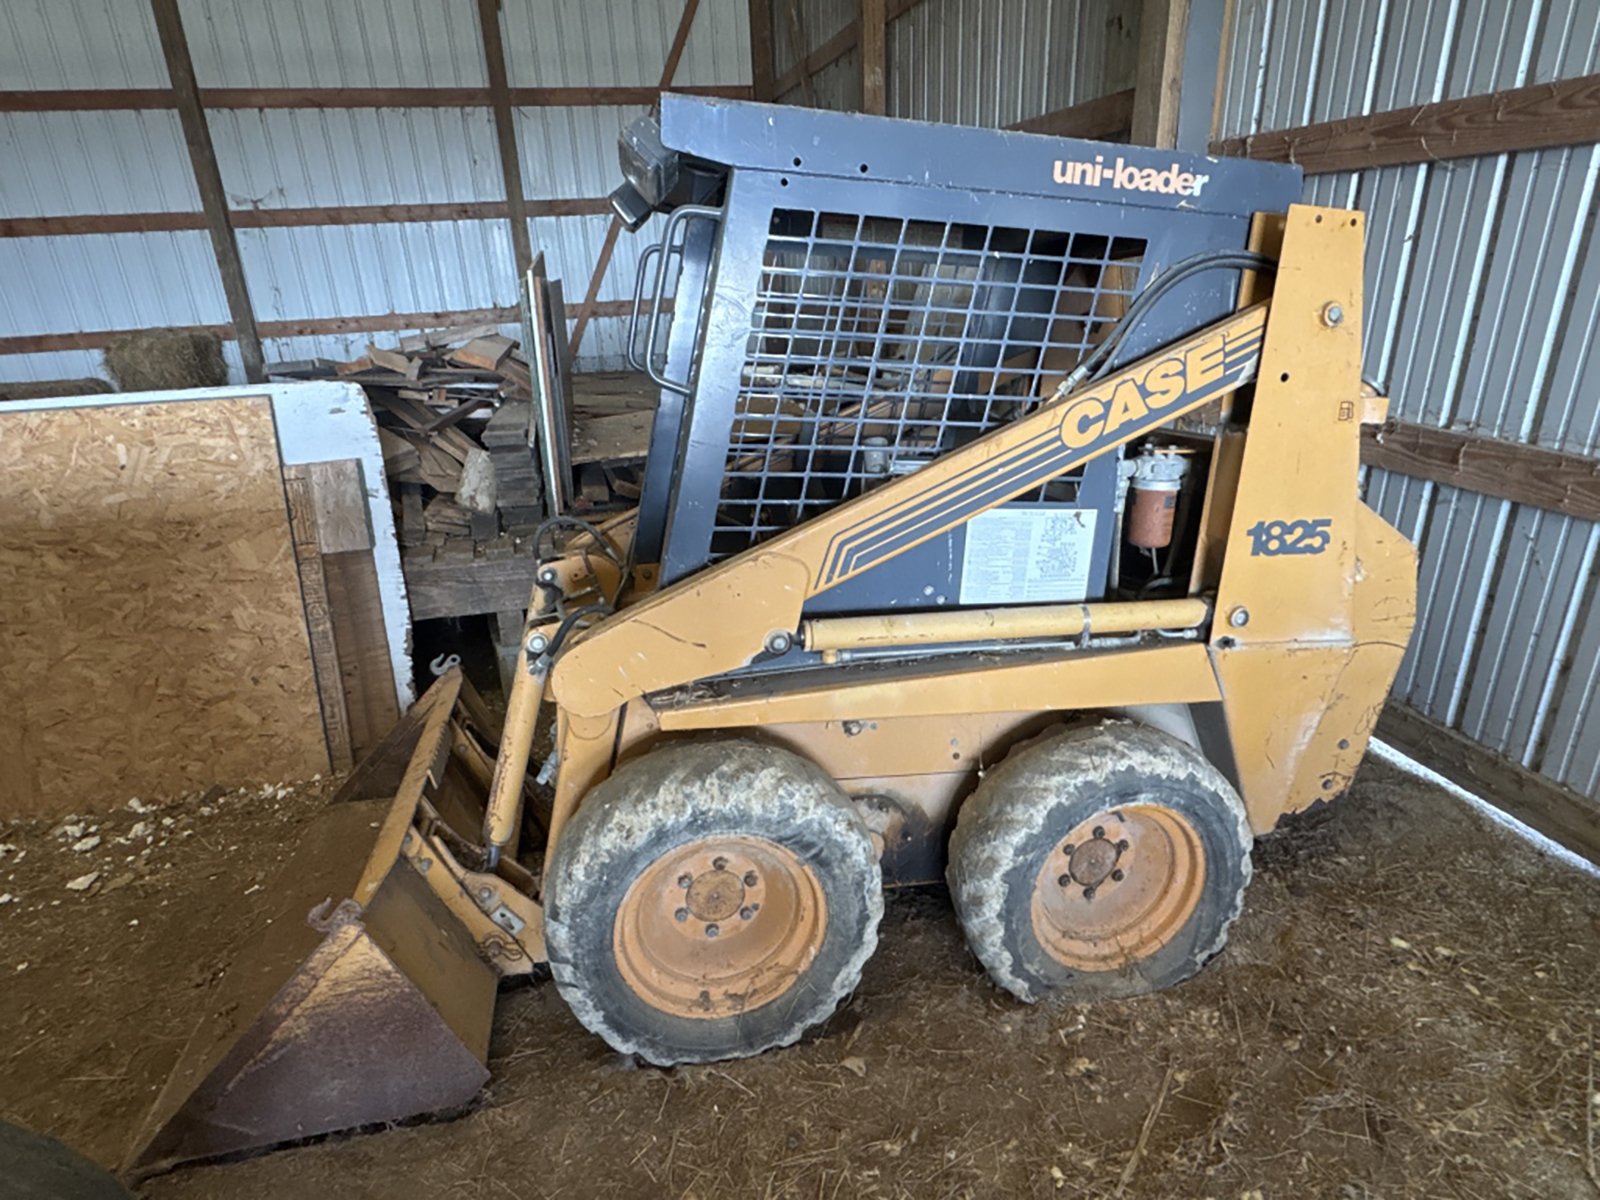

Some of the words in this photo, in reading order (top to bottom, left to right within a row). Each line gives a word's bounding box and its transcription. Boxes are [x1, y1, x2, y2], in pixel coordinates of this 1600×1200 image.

[1053, 155, 1210, 197] uni-loader
[1060, 334, 1226, 449] CASE
[1246, 518, 1332, 556] 1825
